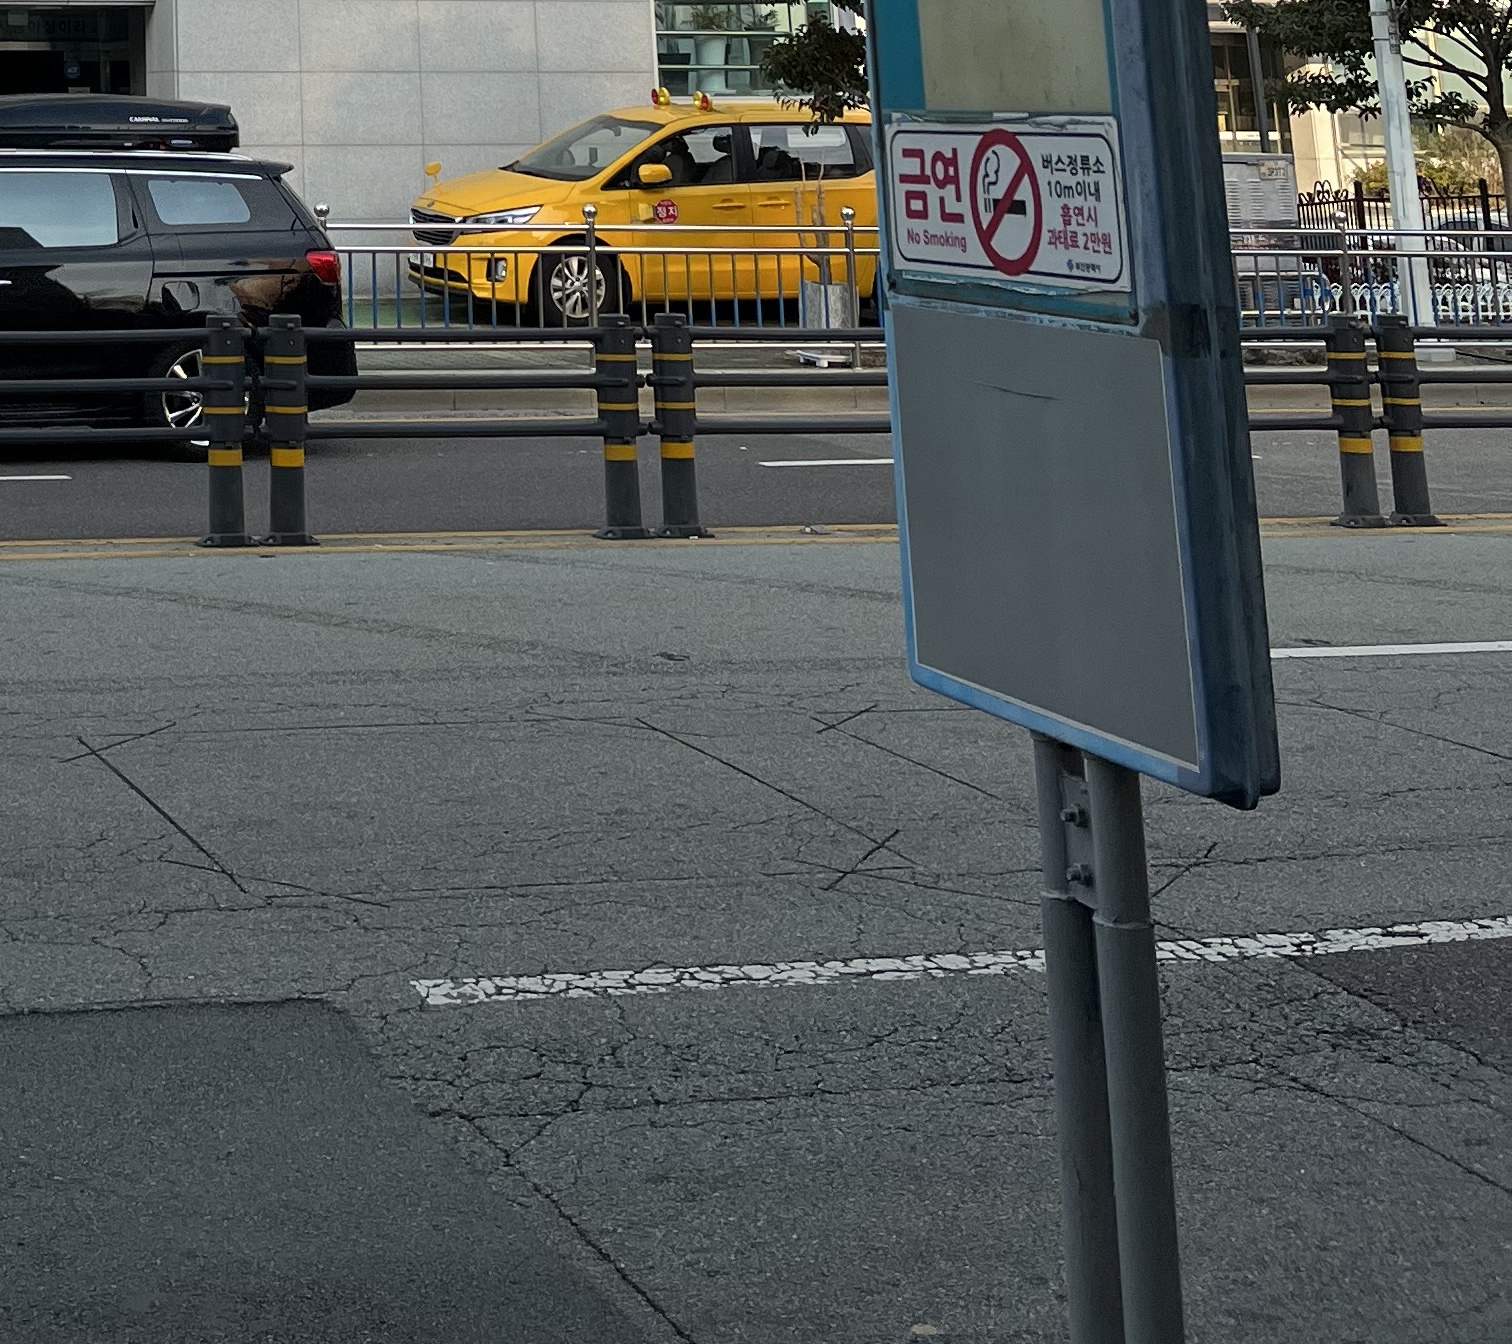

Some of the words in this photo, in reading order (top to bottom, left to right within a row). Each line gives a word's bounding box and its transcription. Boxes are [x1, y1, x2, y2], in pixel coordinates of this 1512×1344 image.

[1041, 153, 1106, 177] 버스정류소
[899, 146, 966, 225] 금연
[656, 205, 678, 218] 정지
[906, 228, 921, 246] No
[922, 229, 968, 254] Smoking
[1047, 227, 1081, 251] 과태료
[1082, 232, 1113, 256] 2만원
